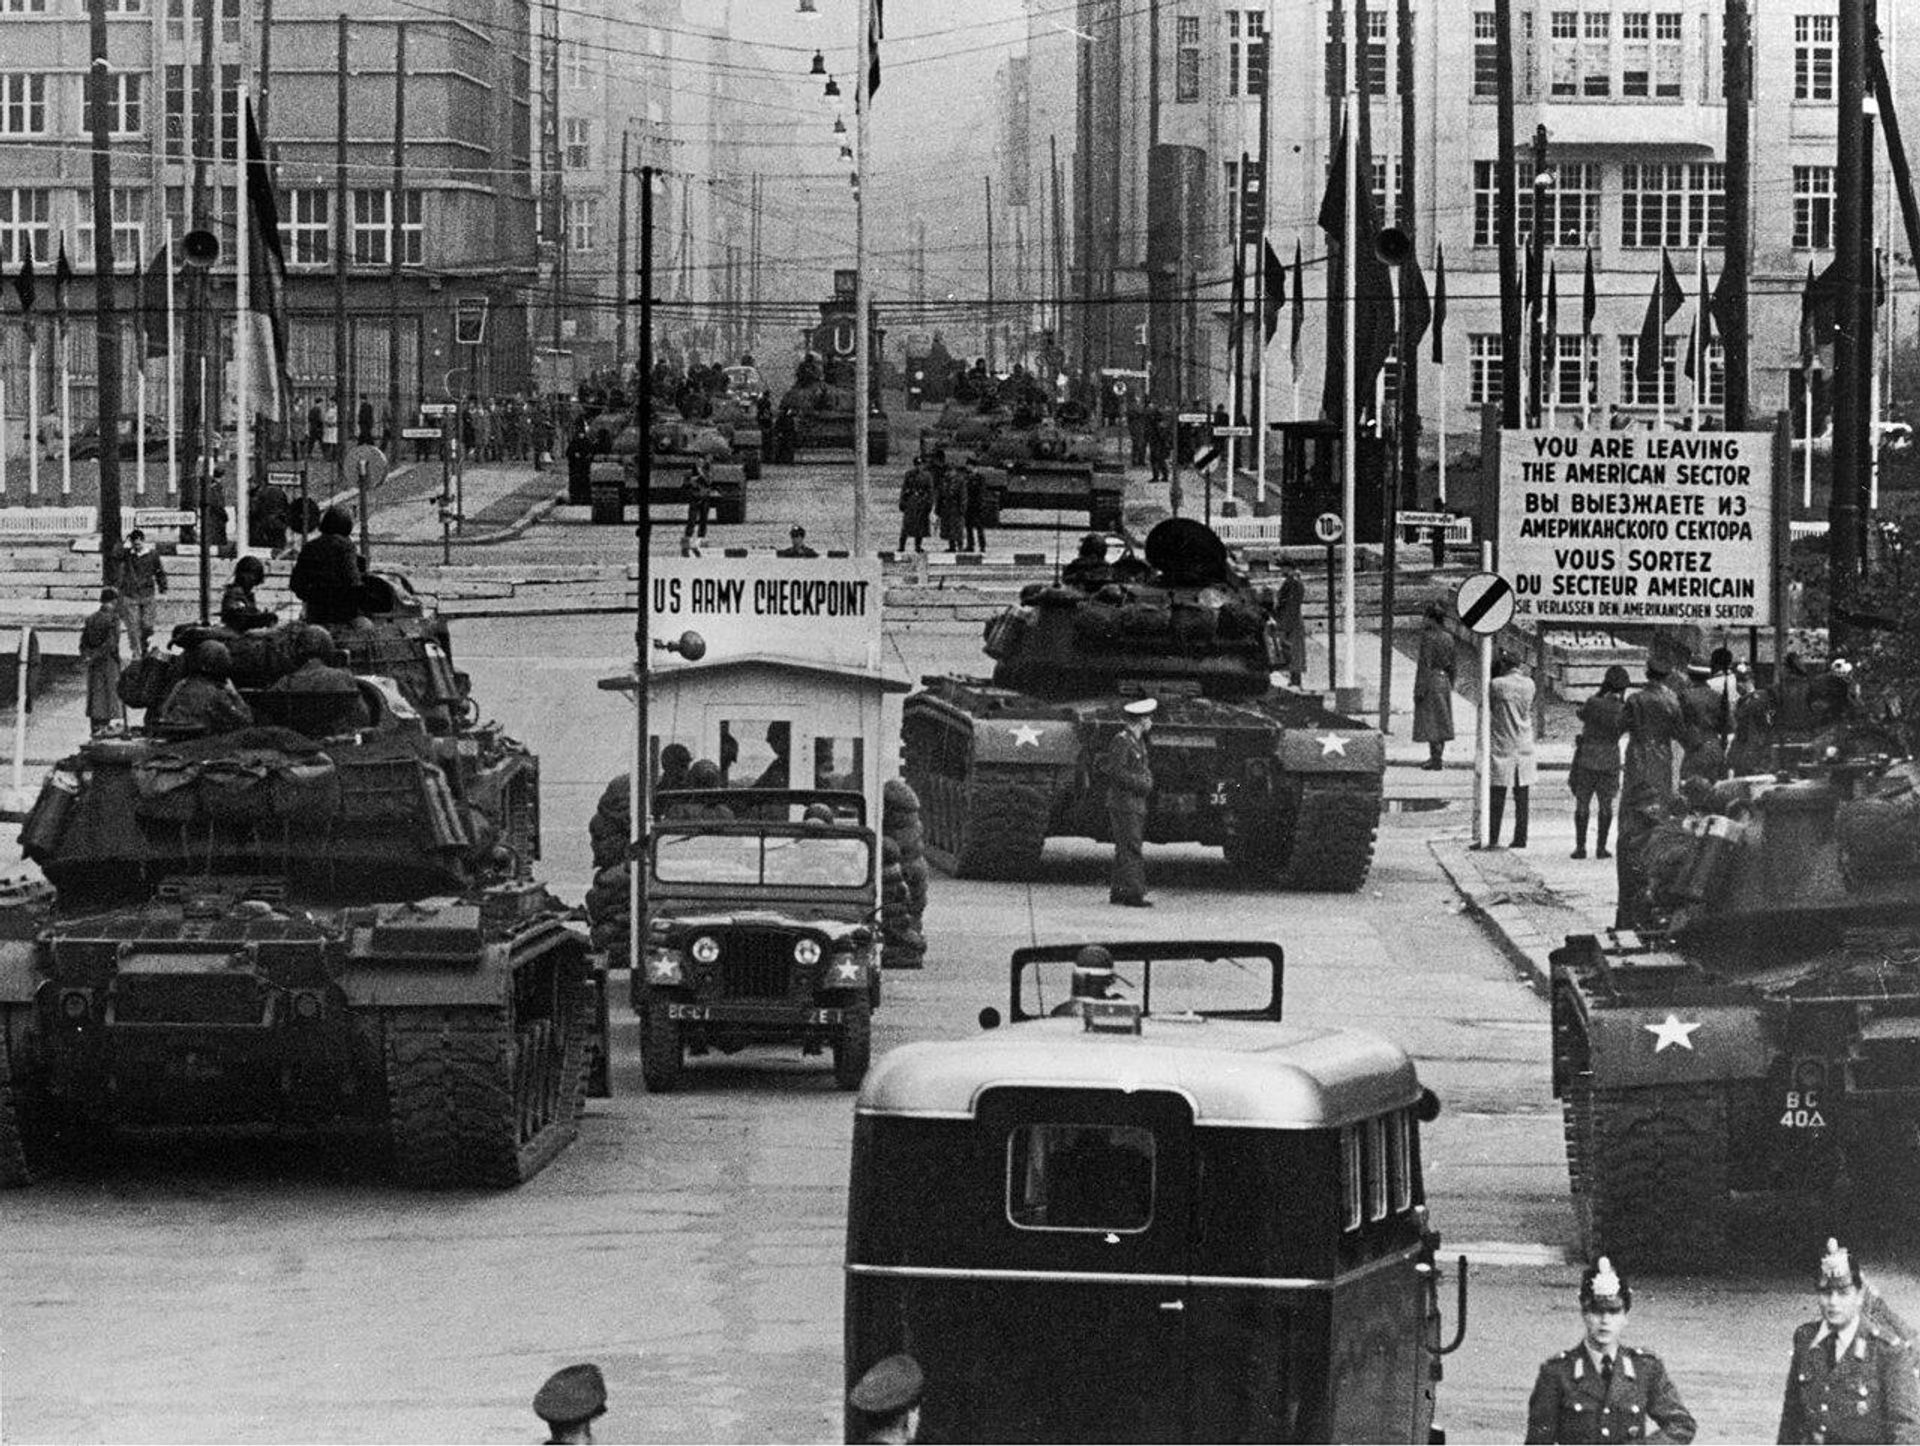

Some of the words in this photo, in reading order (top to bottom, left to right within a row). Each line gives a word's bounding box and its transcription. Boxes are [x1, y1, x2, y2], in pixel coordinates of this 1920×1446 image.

[1534, 437, 1577, 458] YOU
[1590, 438, 1633, 459] ARE
[1647, 438, 1739, 460] LEAVING
[1522, 462, 1555, 482] THE
[1565, 463, 1665, 485] AMERICAN
[1677, 464, 1750, 485] SECTOR
[1525, 493, 1559, 513] ВЫ
[1571, 493, 1704, 515] ВЫЕЗЖАЕТЕ
[1718, 496, 1747, 516] ИЗ
[1319, 517, 1333, 536] 10
[1520, 518, 1668, 541] АМЕРИКАНСКОГО
[1675, 520, 1752, 541] СЕКТОРА
[1555, 549, 1615, 570] VOUS
[1628, 551, 1712, 572] SORTEZ
[653, 578, 681, 614] US
[692, 578, 745, 614] ARMY
[754, 579, 868, 616] CHECKPOINT
[1516, 574, 1541, 595] DU
[1552, 576, 1638, 597] SECTEUR
[1647, 577, 1755, 598] AMERICAIN
[1515, 600, 1531, 615] SIE
[1537, 600, 1594, 615] VERLASSEN
[1598, 601, 1619, 616] DEN
[1622, 602, 1711, 619] AMERIKANISCHEN
[1715, 604, 1754, 619] SEKTOR
